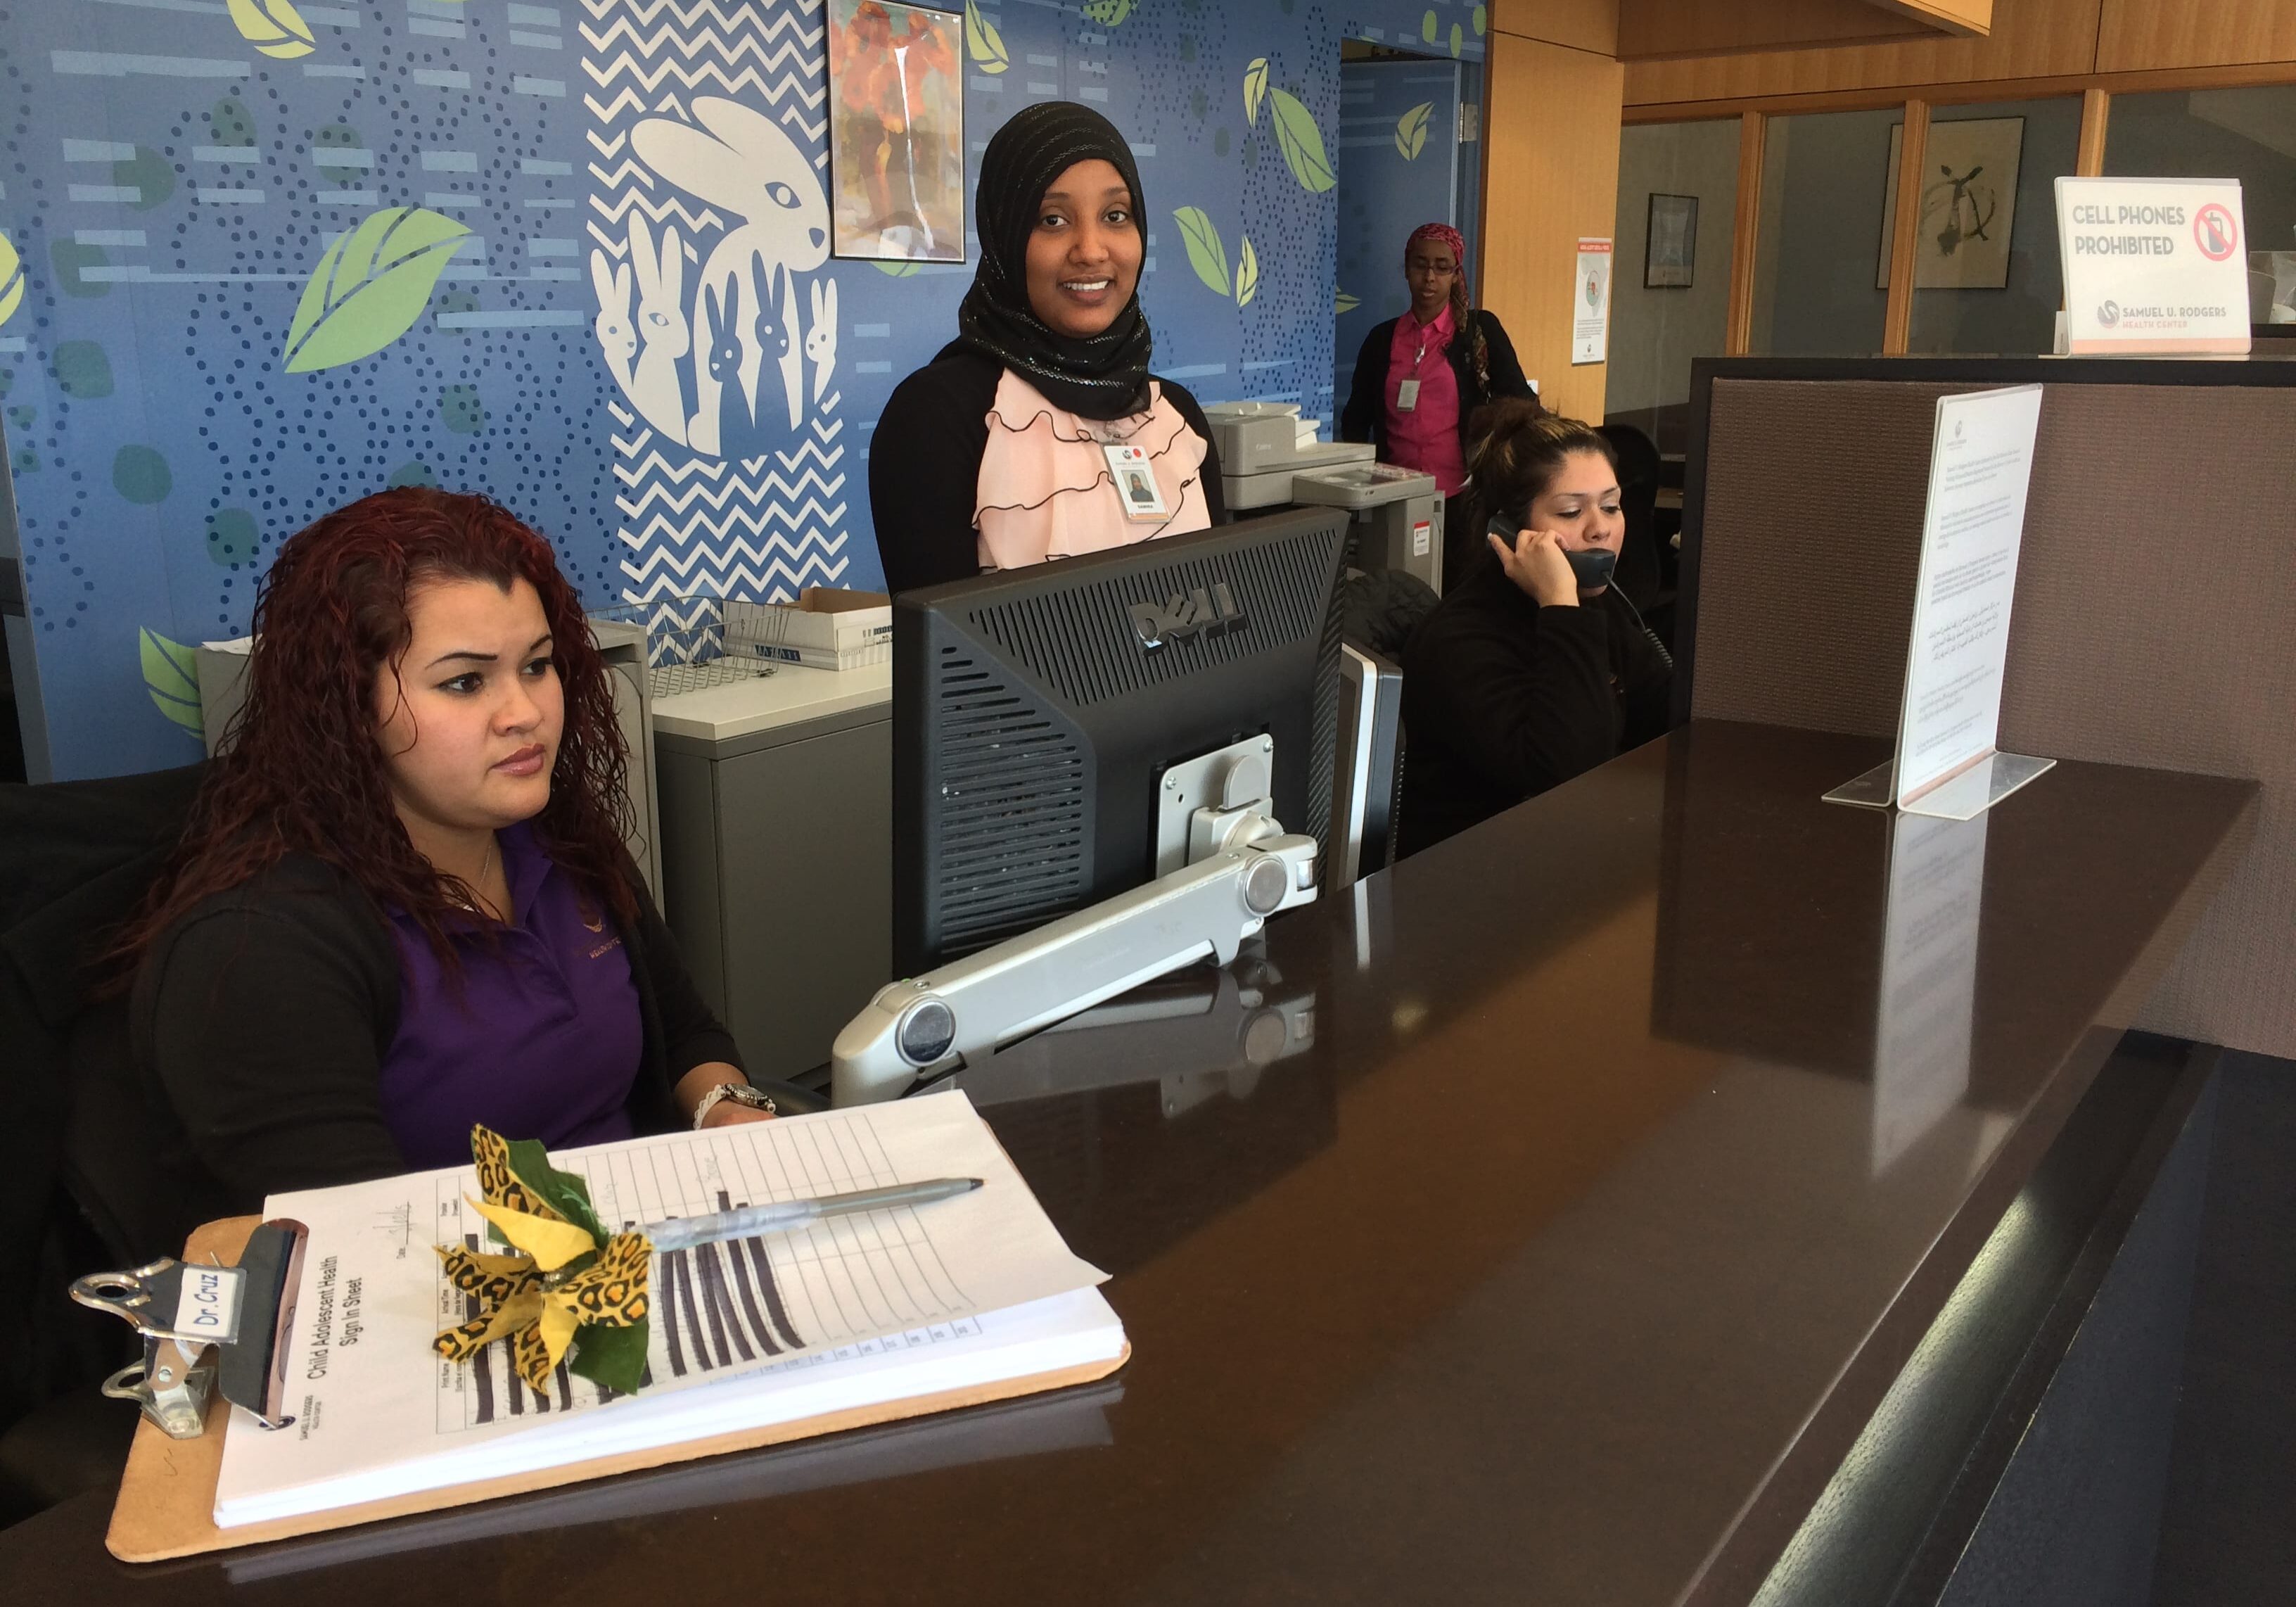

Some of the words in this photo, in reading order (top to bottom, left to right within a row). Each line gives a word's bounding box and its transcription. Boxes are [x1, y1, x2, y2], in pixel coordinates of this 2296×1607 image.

[2072, 205, 2115, 224] CELL
[2118, 205, 2186, 225] PHONES
[2075, 236, 2174, 255] PROHIBITED
[2123, 307, 2164, 317] SAMUEL
[2167, 307, 2176, 317] U.
[2179, 307, 2226, 317] RODGERS
[1129, 583, 1248, 658] DELL
[317, 1255, 338, 1289] Health
[193, 1274, 218, 1303] Cruz
[343, 1277, 362, 1308] Sheet
[193, 1304, 219, 1326] Dr.
[310, 1288, 335, 1346] Adolescent
[341, 1308, 360, 1321] In
[339, 1321, 364, 1347] Sign
[307, 1348, 329, 1380] Child
